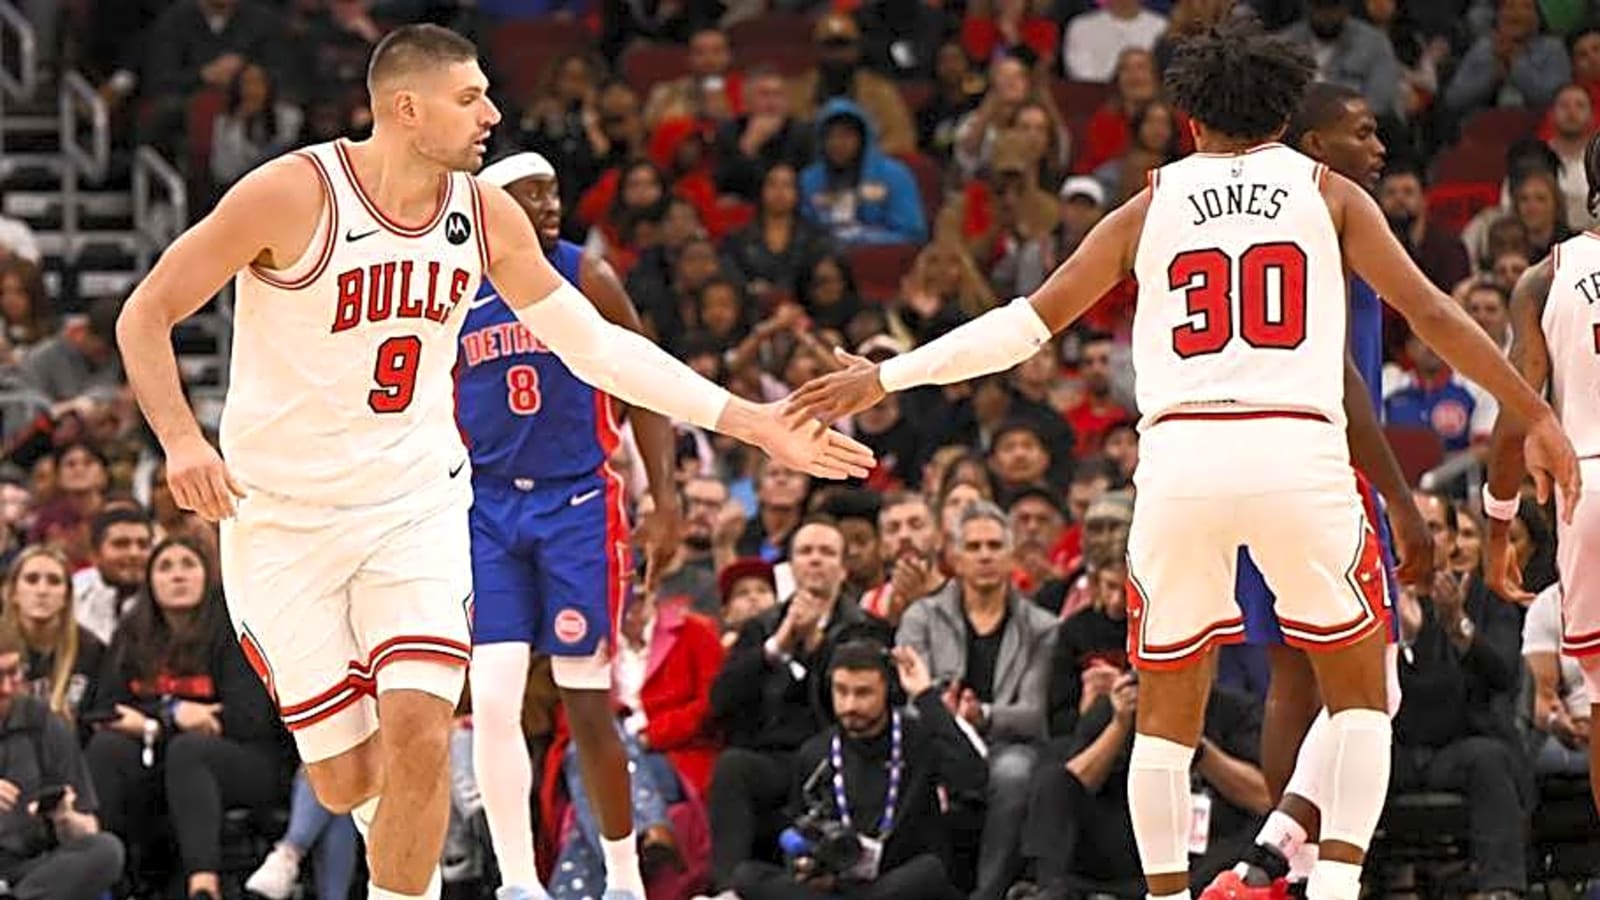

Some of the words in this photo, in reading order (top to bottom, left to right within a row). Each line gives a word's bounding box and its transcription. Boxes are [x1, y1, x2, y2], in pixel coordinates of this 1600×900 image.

[447, 215, 468, 238] M
[1187, 183, 1289, 226] JONES
[331, 260, 471, 334] BULLS
[1167, 241, 1308, 360] 30
[367, 334, 422, 414] 9
[507, 364, 541, 415] 8
